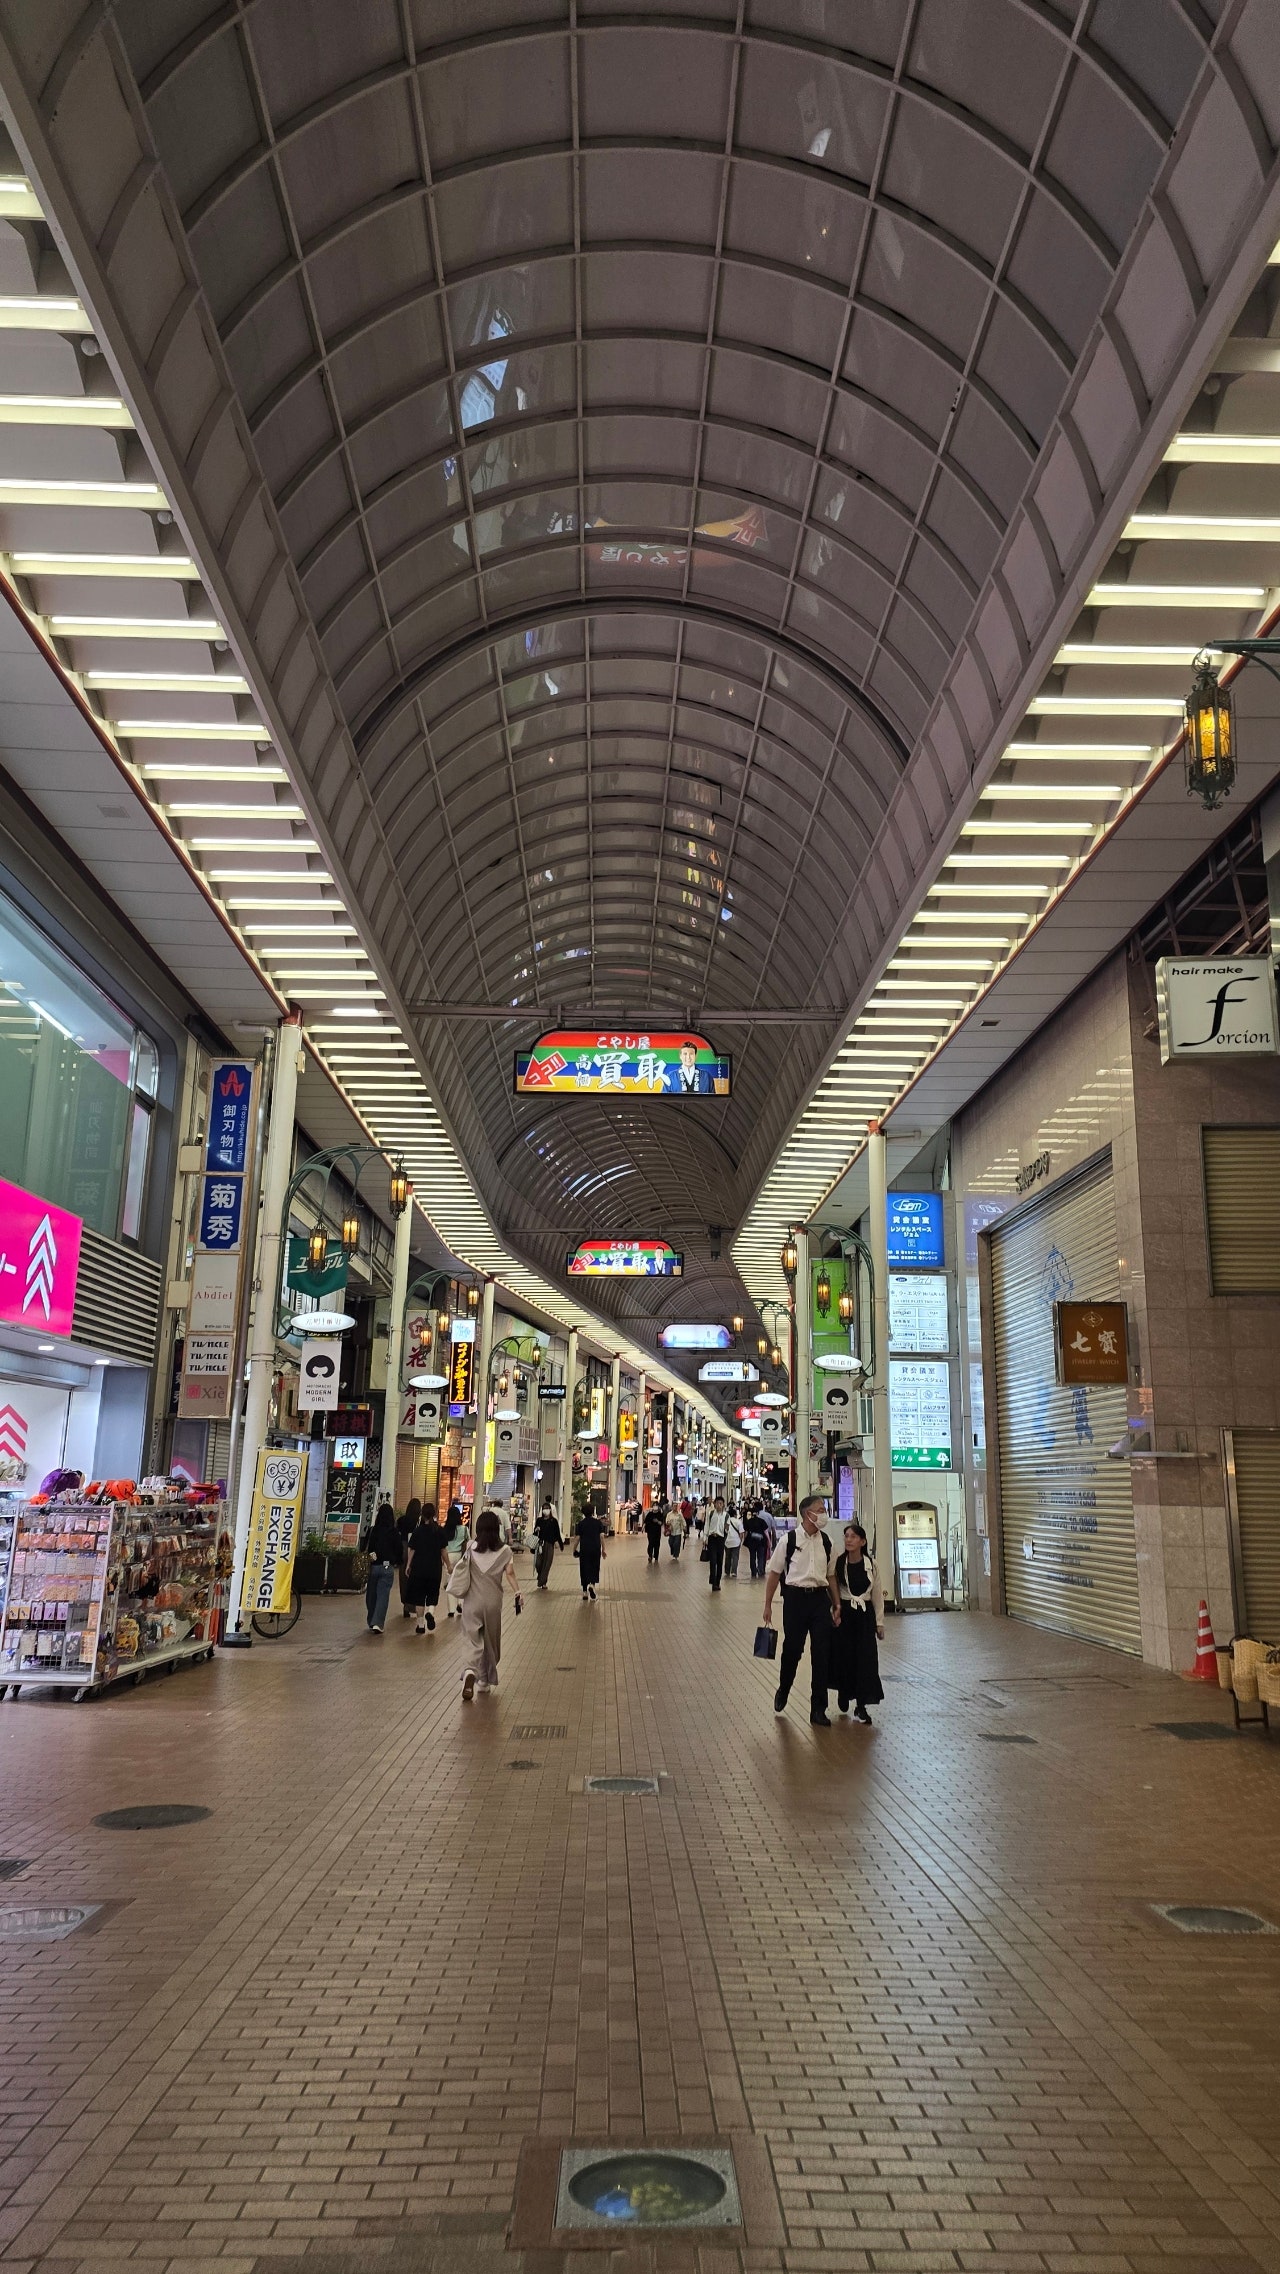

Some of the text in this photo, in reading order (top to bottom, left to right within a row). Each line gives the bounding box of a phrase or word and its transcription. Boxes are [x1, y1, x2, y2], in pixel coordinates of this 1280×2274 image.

[1172, 966, 1243, 975] hair make
[596, 1036, 651, 1050] こやし屋
[593, 1052, 673, 1090] 買取
[219, 1104, 237, 1163] 御刃物司
[207, 1183, 237, 1241] 菊秀
[194, 1291, 232, 1300] Abdiel
[902, 1366, 935, 1375] 貸会議室
[340, 1441, 359, 1460] 取
[279, 1507, 295, 1563] MONEY
[256, 1505, 282, 1609] EXCHANGE
